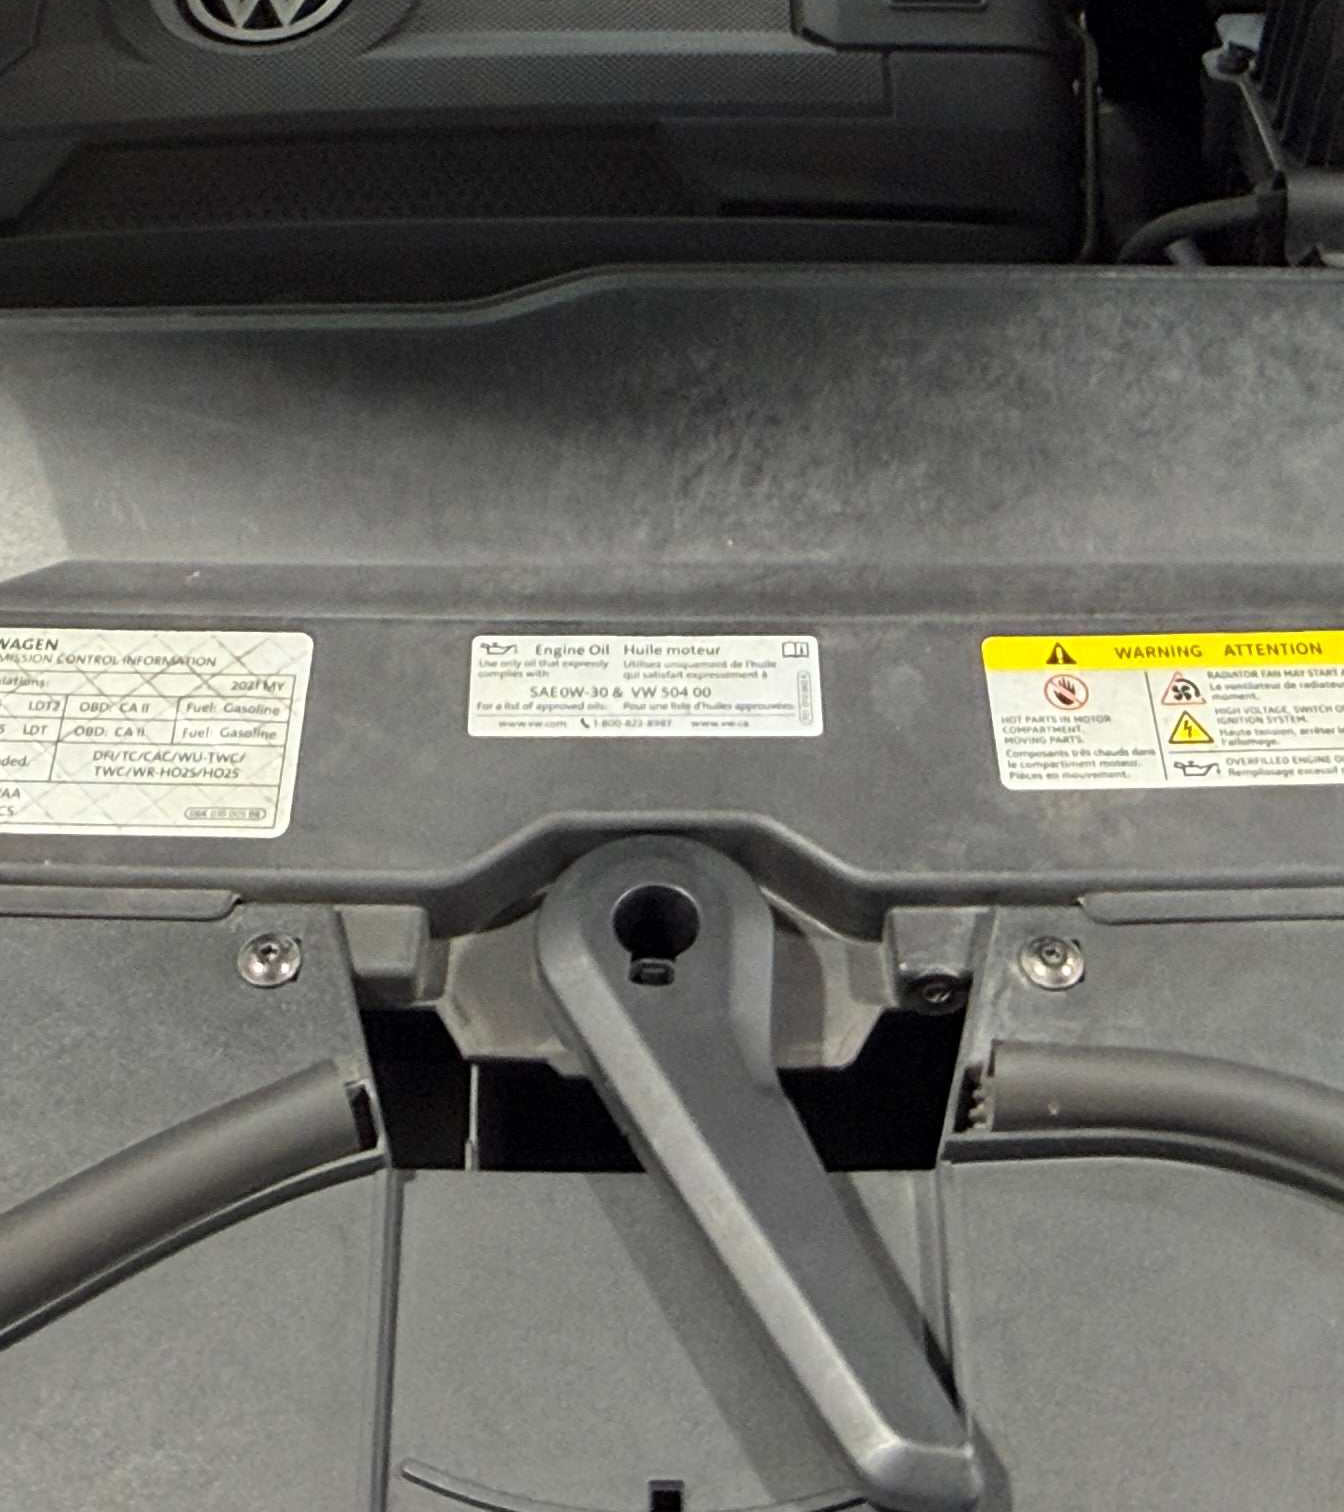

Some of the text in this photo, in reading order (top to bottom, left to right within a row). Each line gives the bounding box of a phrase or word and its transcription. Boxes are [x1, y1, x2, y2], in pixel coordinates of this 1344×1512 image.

[535, 644, 721, 658] Engine Oil Huile moteur
[1113, 642, 1324, 661] WARNING ATTENTION
[57, 654, 118, 666] CONTROL
[122, 655, 217, 668] INFORMATION
[478, 659, 610, 670] Use only that expressly
[477, 670, 550, 680] complies with
[1283, 669, 1305, 677] MAY
[1307, 668, 1339, 677] START
[529, 686, 712, 698] SAE 0W-30 & VW 504 00
[119, 702, 138, 713] CA
[223, 703, 281, 716] Gasoline
[476, 701, 585, 712] For list of approved
[1293, 704, 1333, 714] SWITCH
[1000, 714, 1112, 725] HOT PARTS MOTOR
[1216, 715, 1264, 725] IGNITION
[220, 728, 277, 741] Gasoline
[1004, 735, 1047, 745] MOVING
[1006, 747, 1156, 760] Composants chauds dans
[1019, 759, 1096, 771] compartiment
